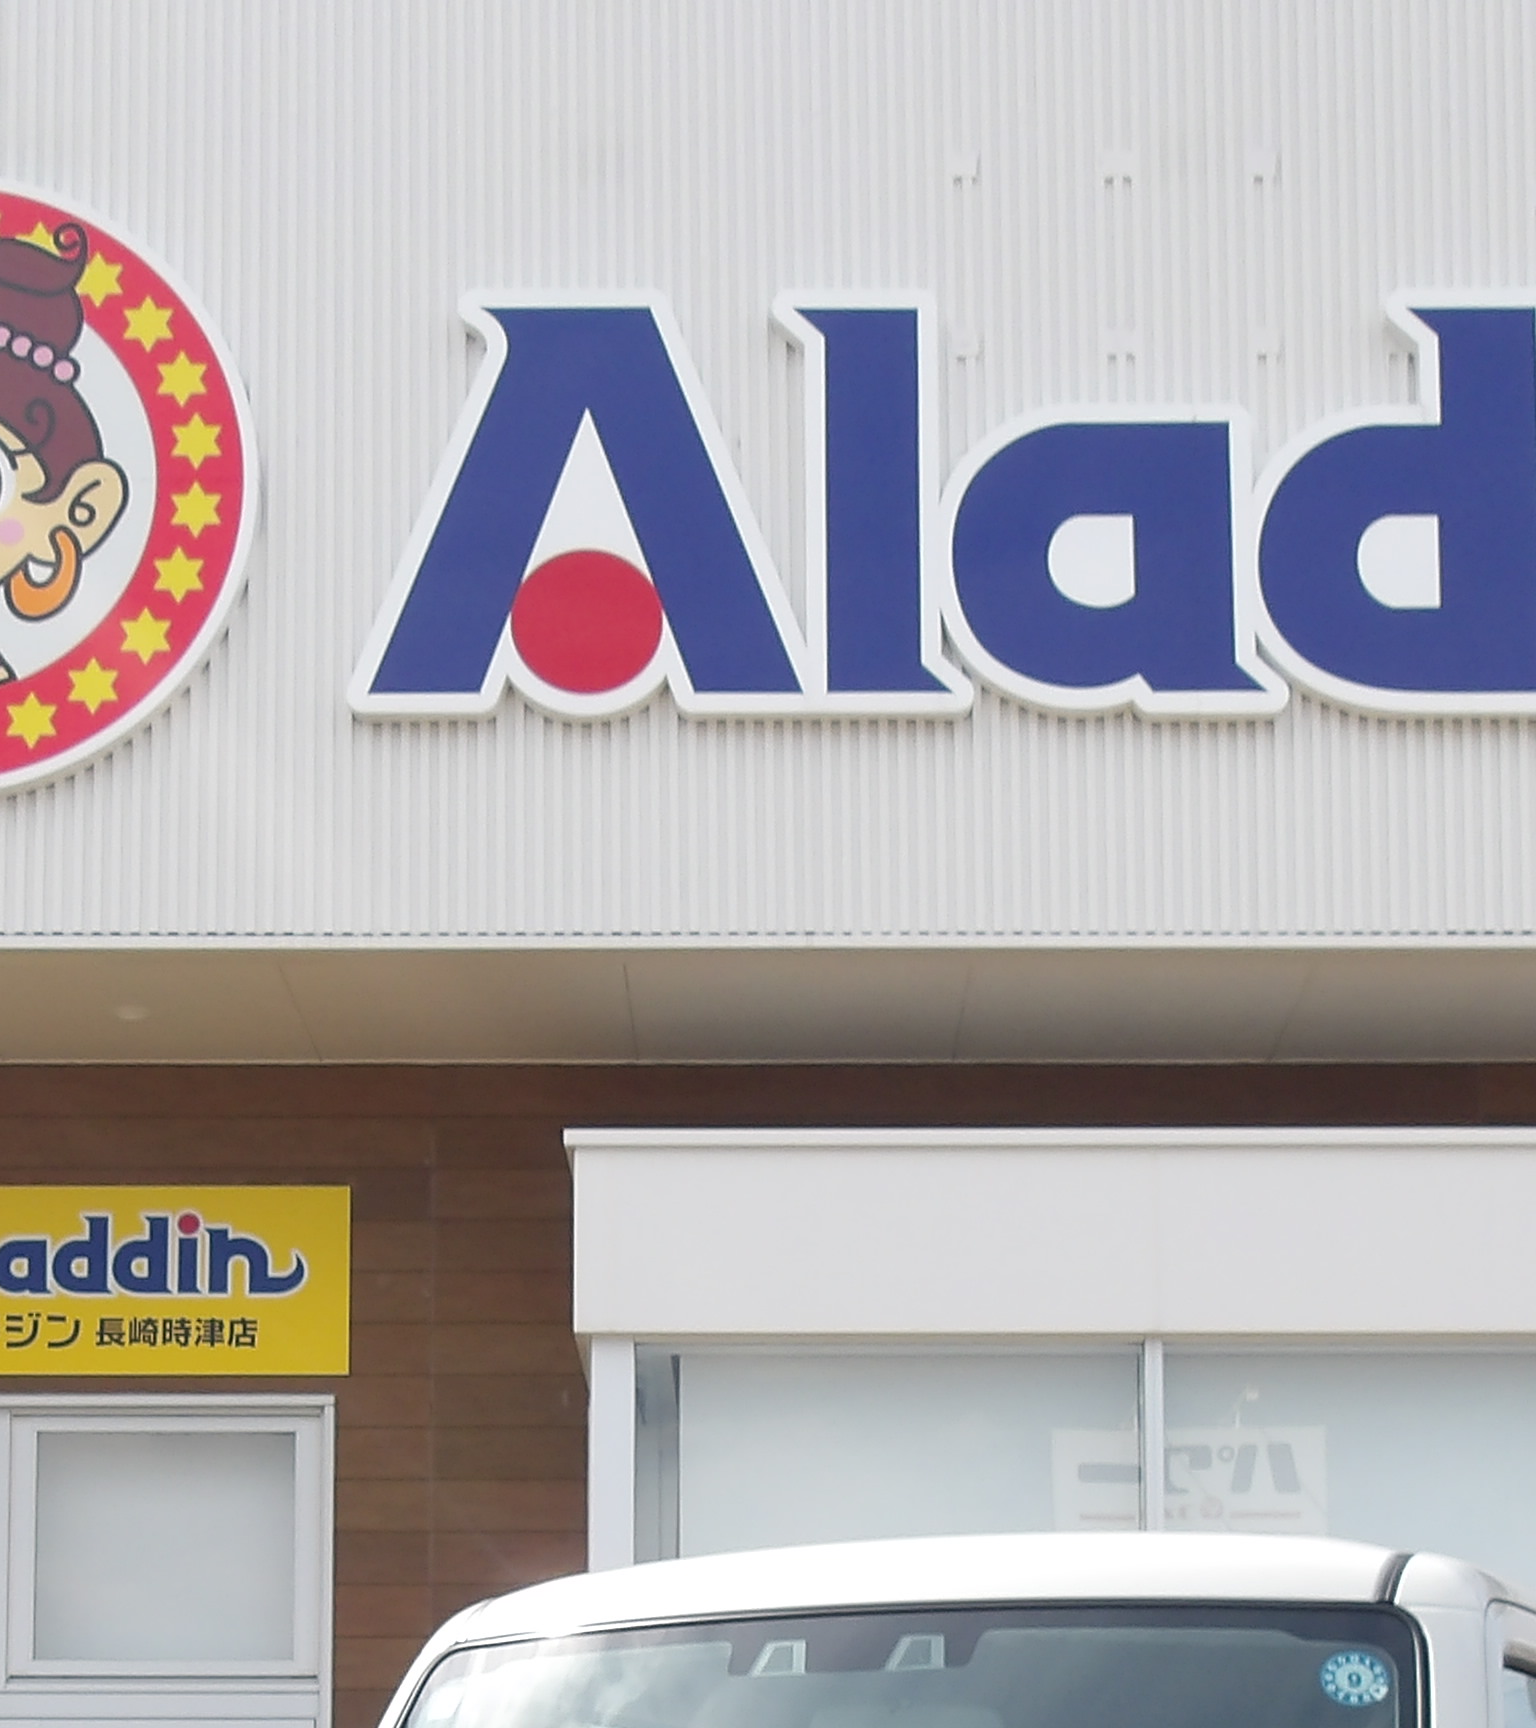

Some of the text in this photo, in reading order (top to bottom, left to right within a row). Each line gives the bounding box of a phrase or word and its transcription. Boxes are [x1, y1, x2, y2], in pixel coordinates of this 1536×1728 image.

[95, 1317, 258, 1348] 長崎時津店
